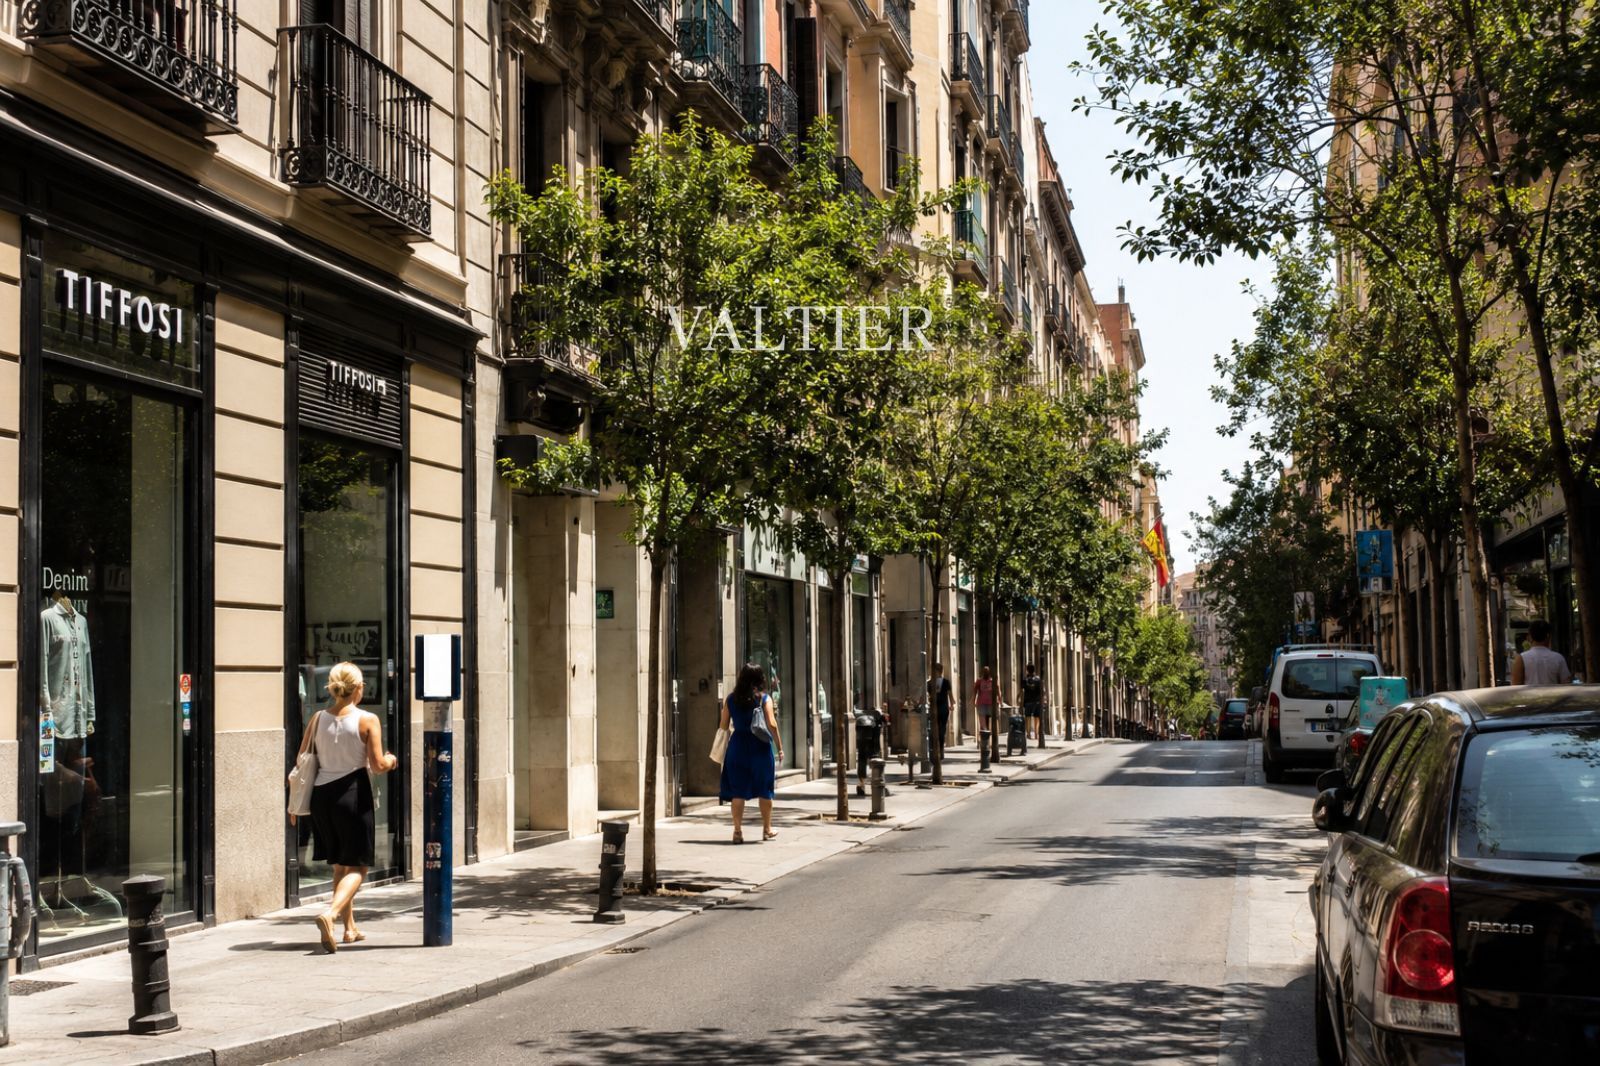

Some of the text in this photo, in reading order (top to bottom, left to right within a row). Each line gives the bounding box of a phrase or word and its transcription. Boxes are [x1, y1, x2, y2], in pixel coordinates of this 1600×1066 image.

[62, 268, 183, 343] TIFFOSI
[330, 360, 376, 393] TIFFOSI
[42, 566, 89, 592] Denim
